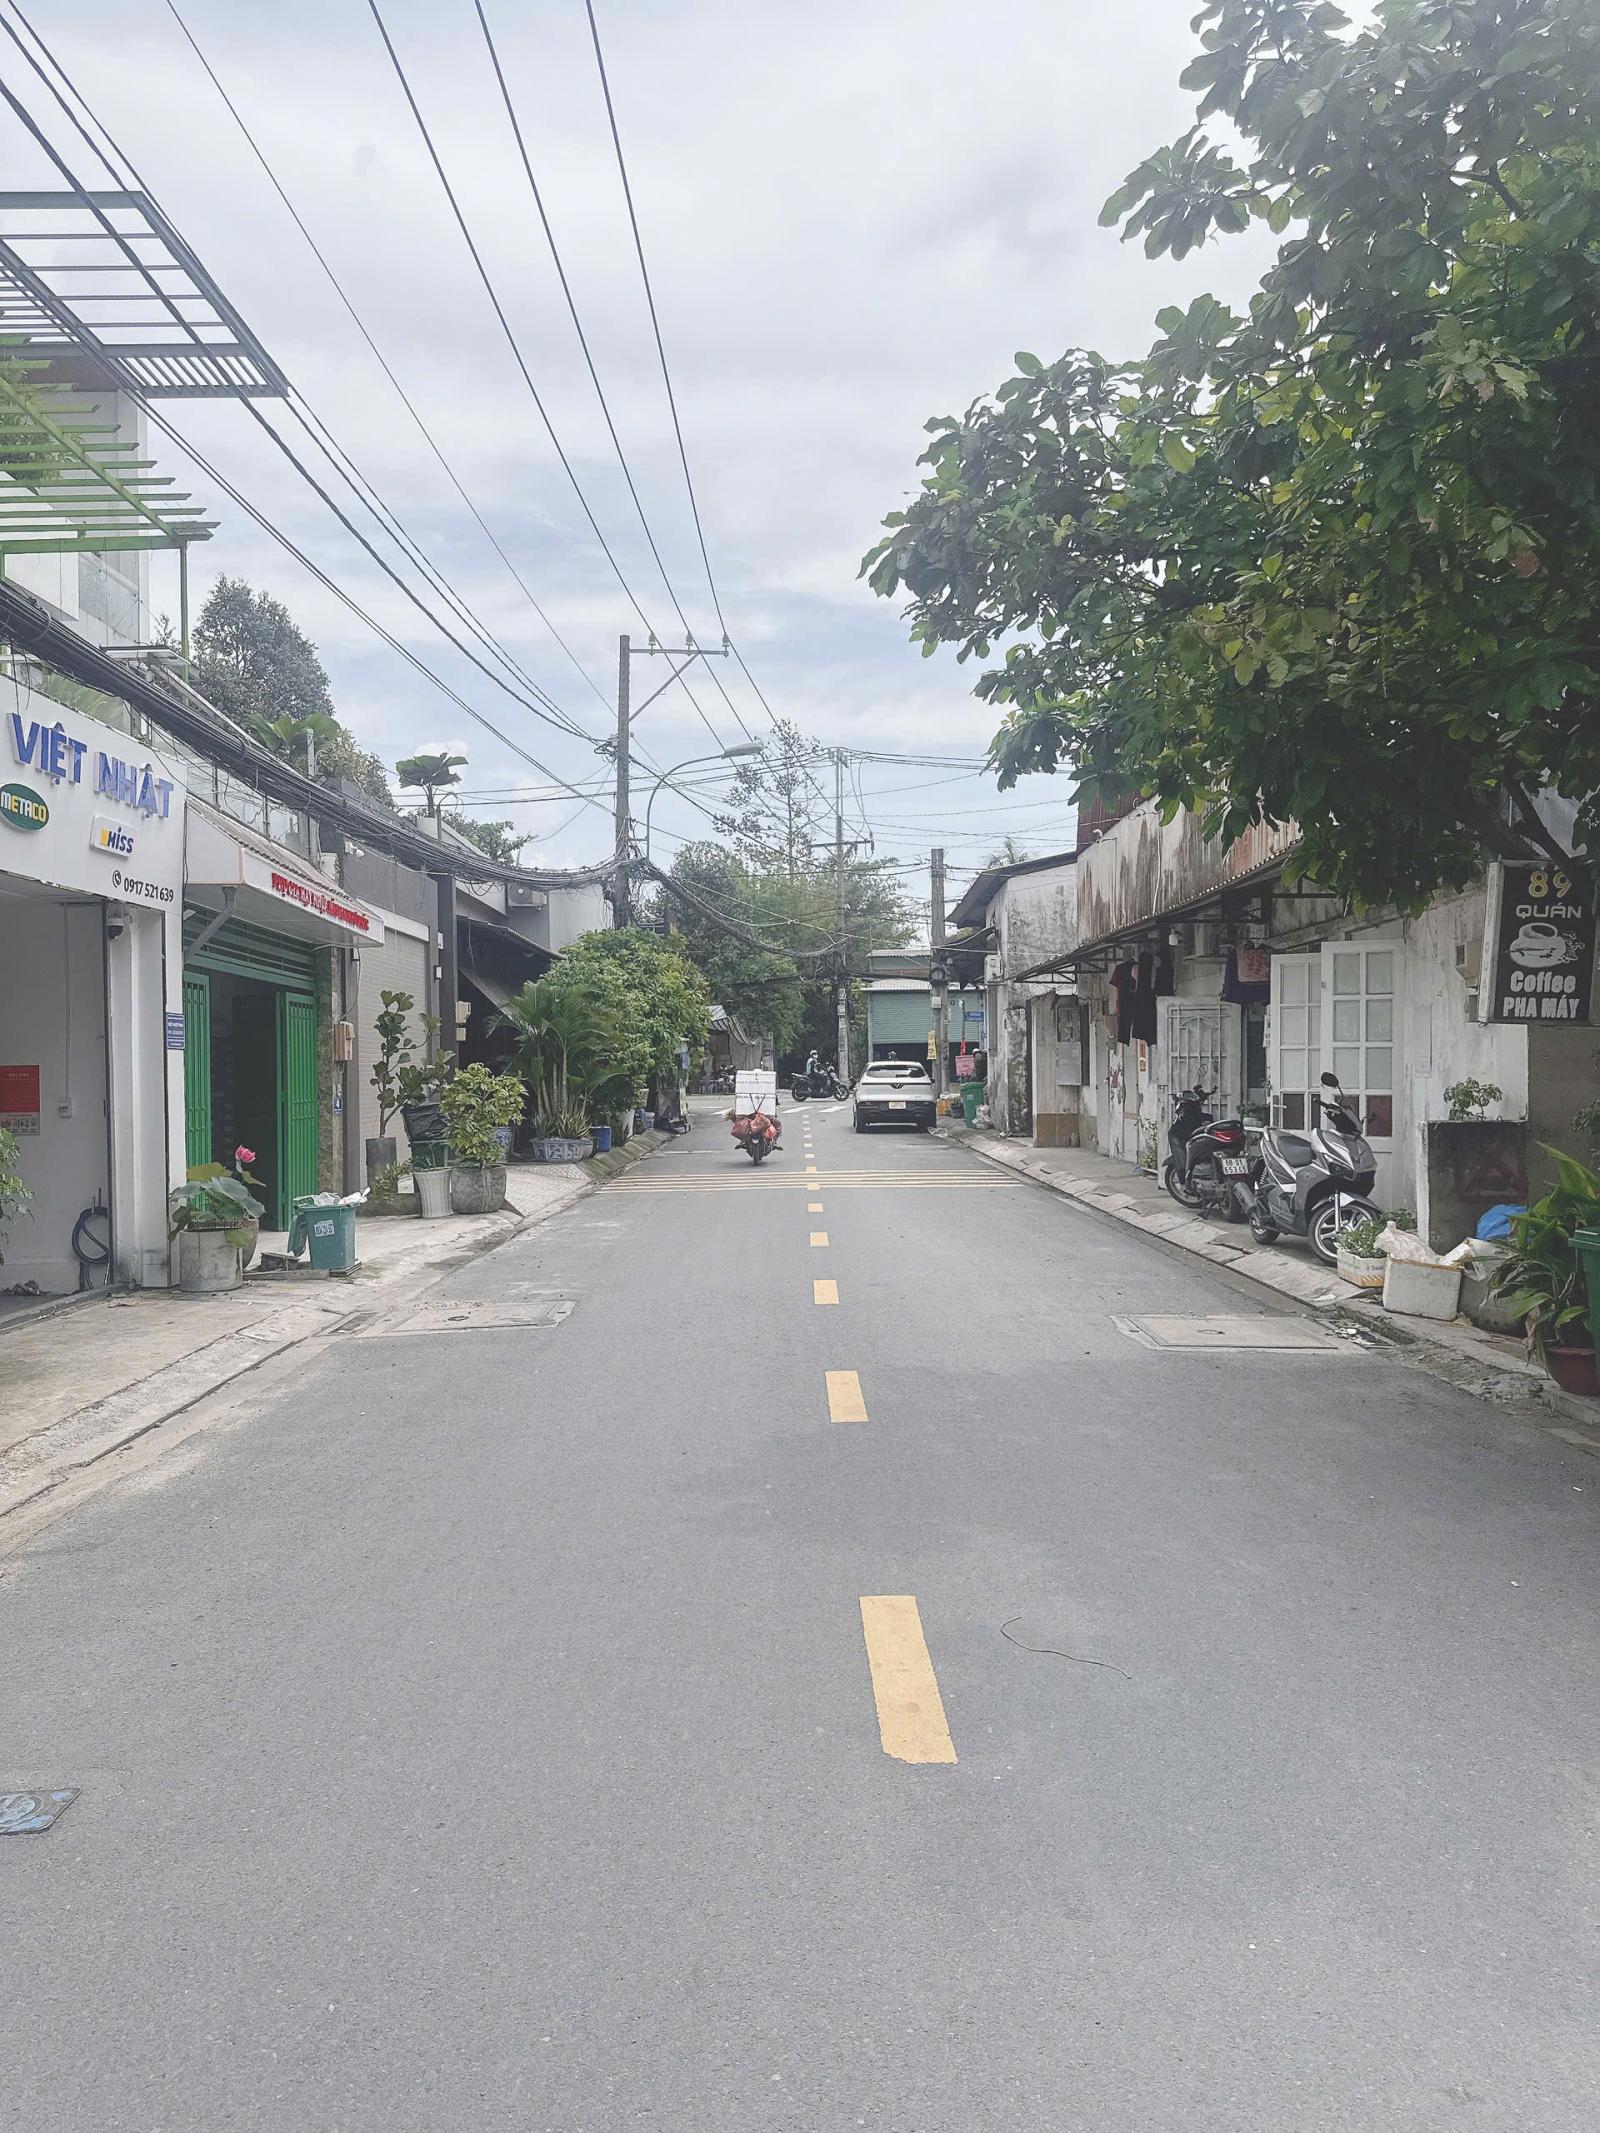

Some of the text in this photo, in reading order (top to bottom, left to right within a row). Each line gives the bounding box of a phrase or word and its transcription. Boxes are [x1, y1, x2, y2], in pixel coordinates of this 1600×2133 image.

[8, 712, 174, 818] VIỆT NHẬT
[1, 791, 47, 823] METACO
[123, 877, 144, 896] 0917
[1528, 871, 1572, 898] 89
[1516, 902, 1582, 919] QUÁN
[1510, 971, 1576, 993] Coffee
[1503, 995, 1580, 1019] PHA MÁY
